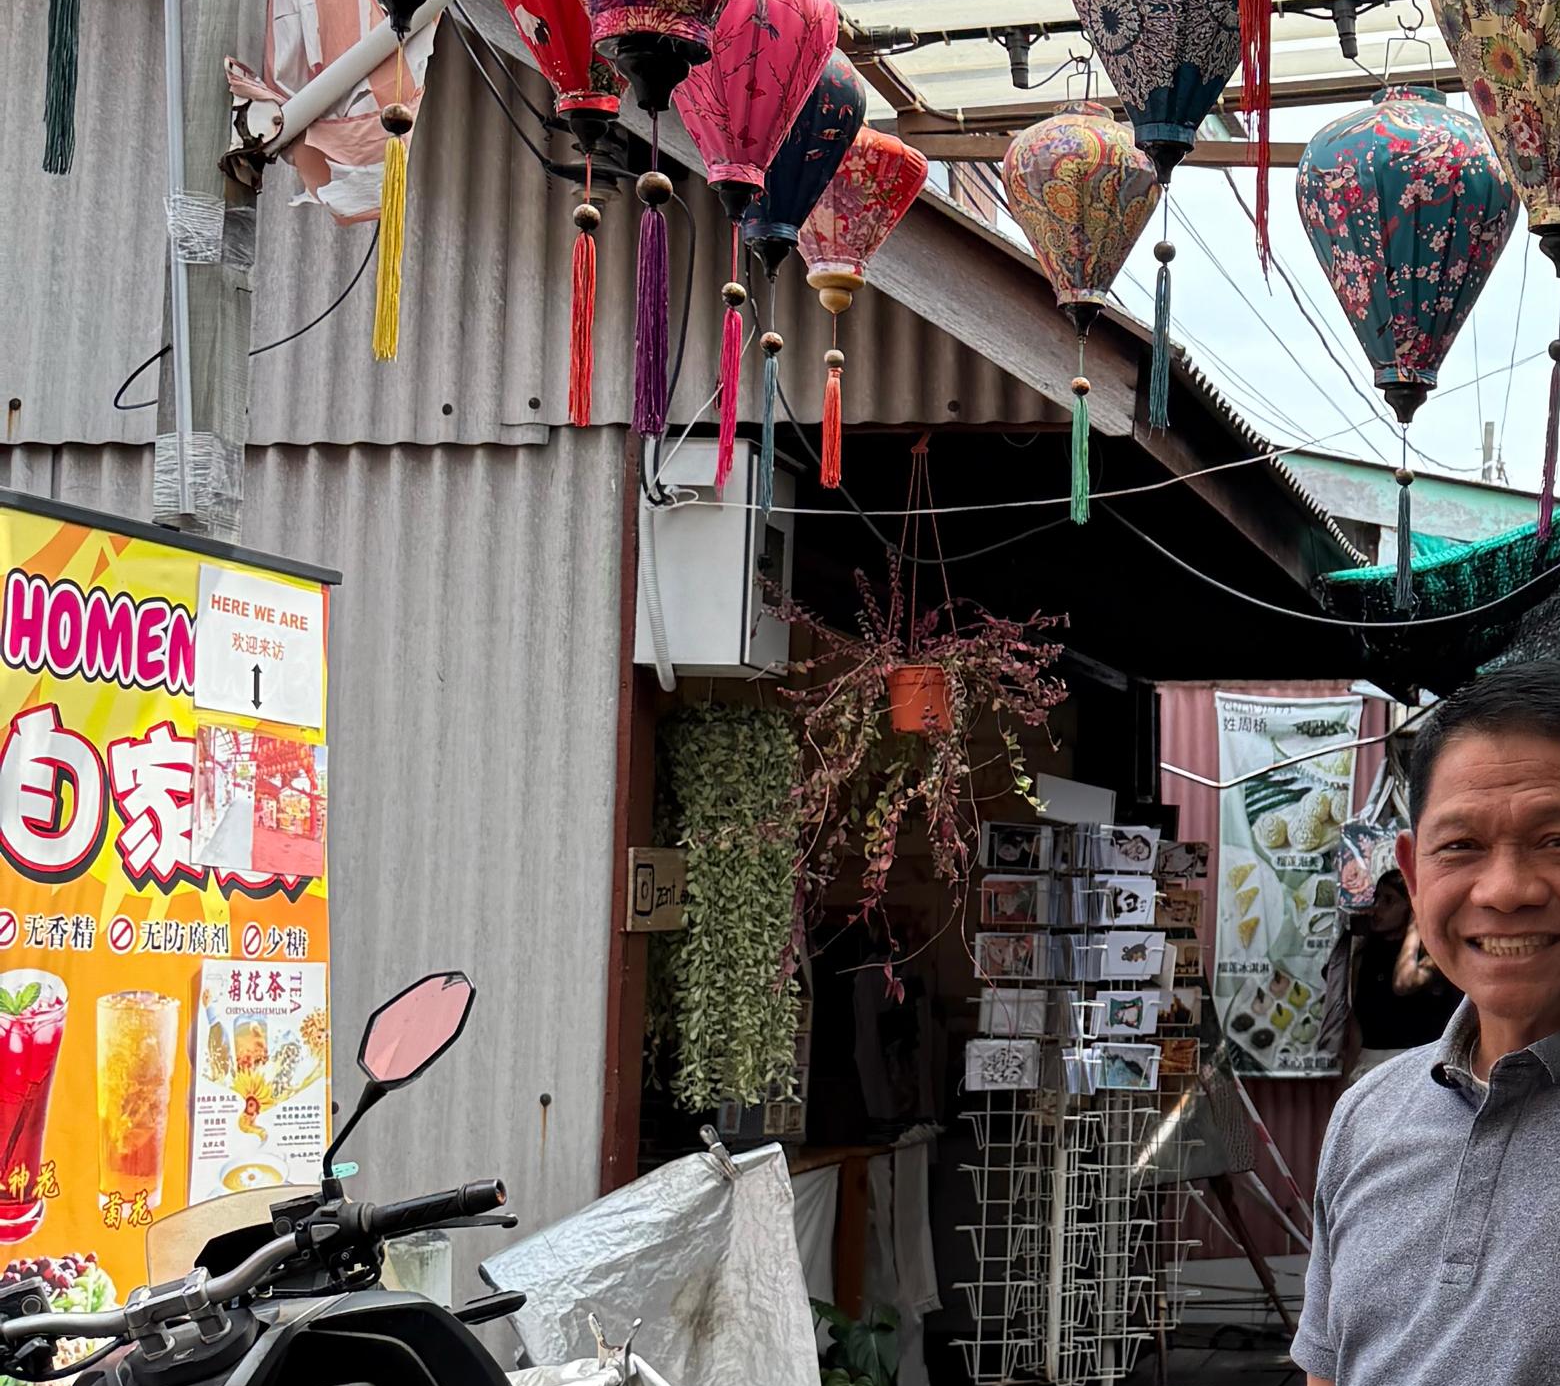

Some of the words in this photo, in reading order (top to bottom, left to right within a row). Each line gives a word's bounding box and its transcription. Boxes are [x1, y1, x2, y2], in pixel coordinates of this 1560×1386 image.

[211, 594, 250, 618] HERE
[254, 604, 276, 624] WE
[279, 611, 309, 632] ARE
[231, 632, 286, 662] 欢迎来访
[0, 703, 312, 903] 自家
[25, 914, 96, 949] 无香精
[141, 919, 230, 954] 无防腐剂
[265, 926, 308, 957] 少糖
[228, 969, 286, 1002] 菊花茶
[289, 971, 302, 1014] TEA
[0, 1160, 60, 1204] 神花
[103, 1189, 153, 1230] 菊花
